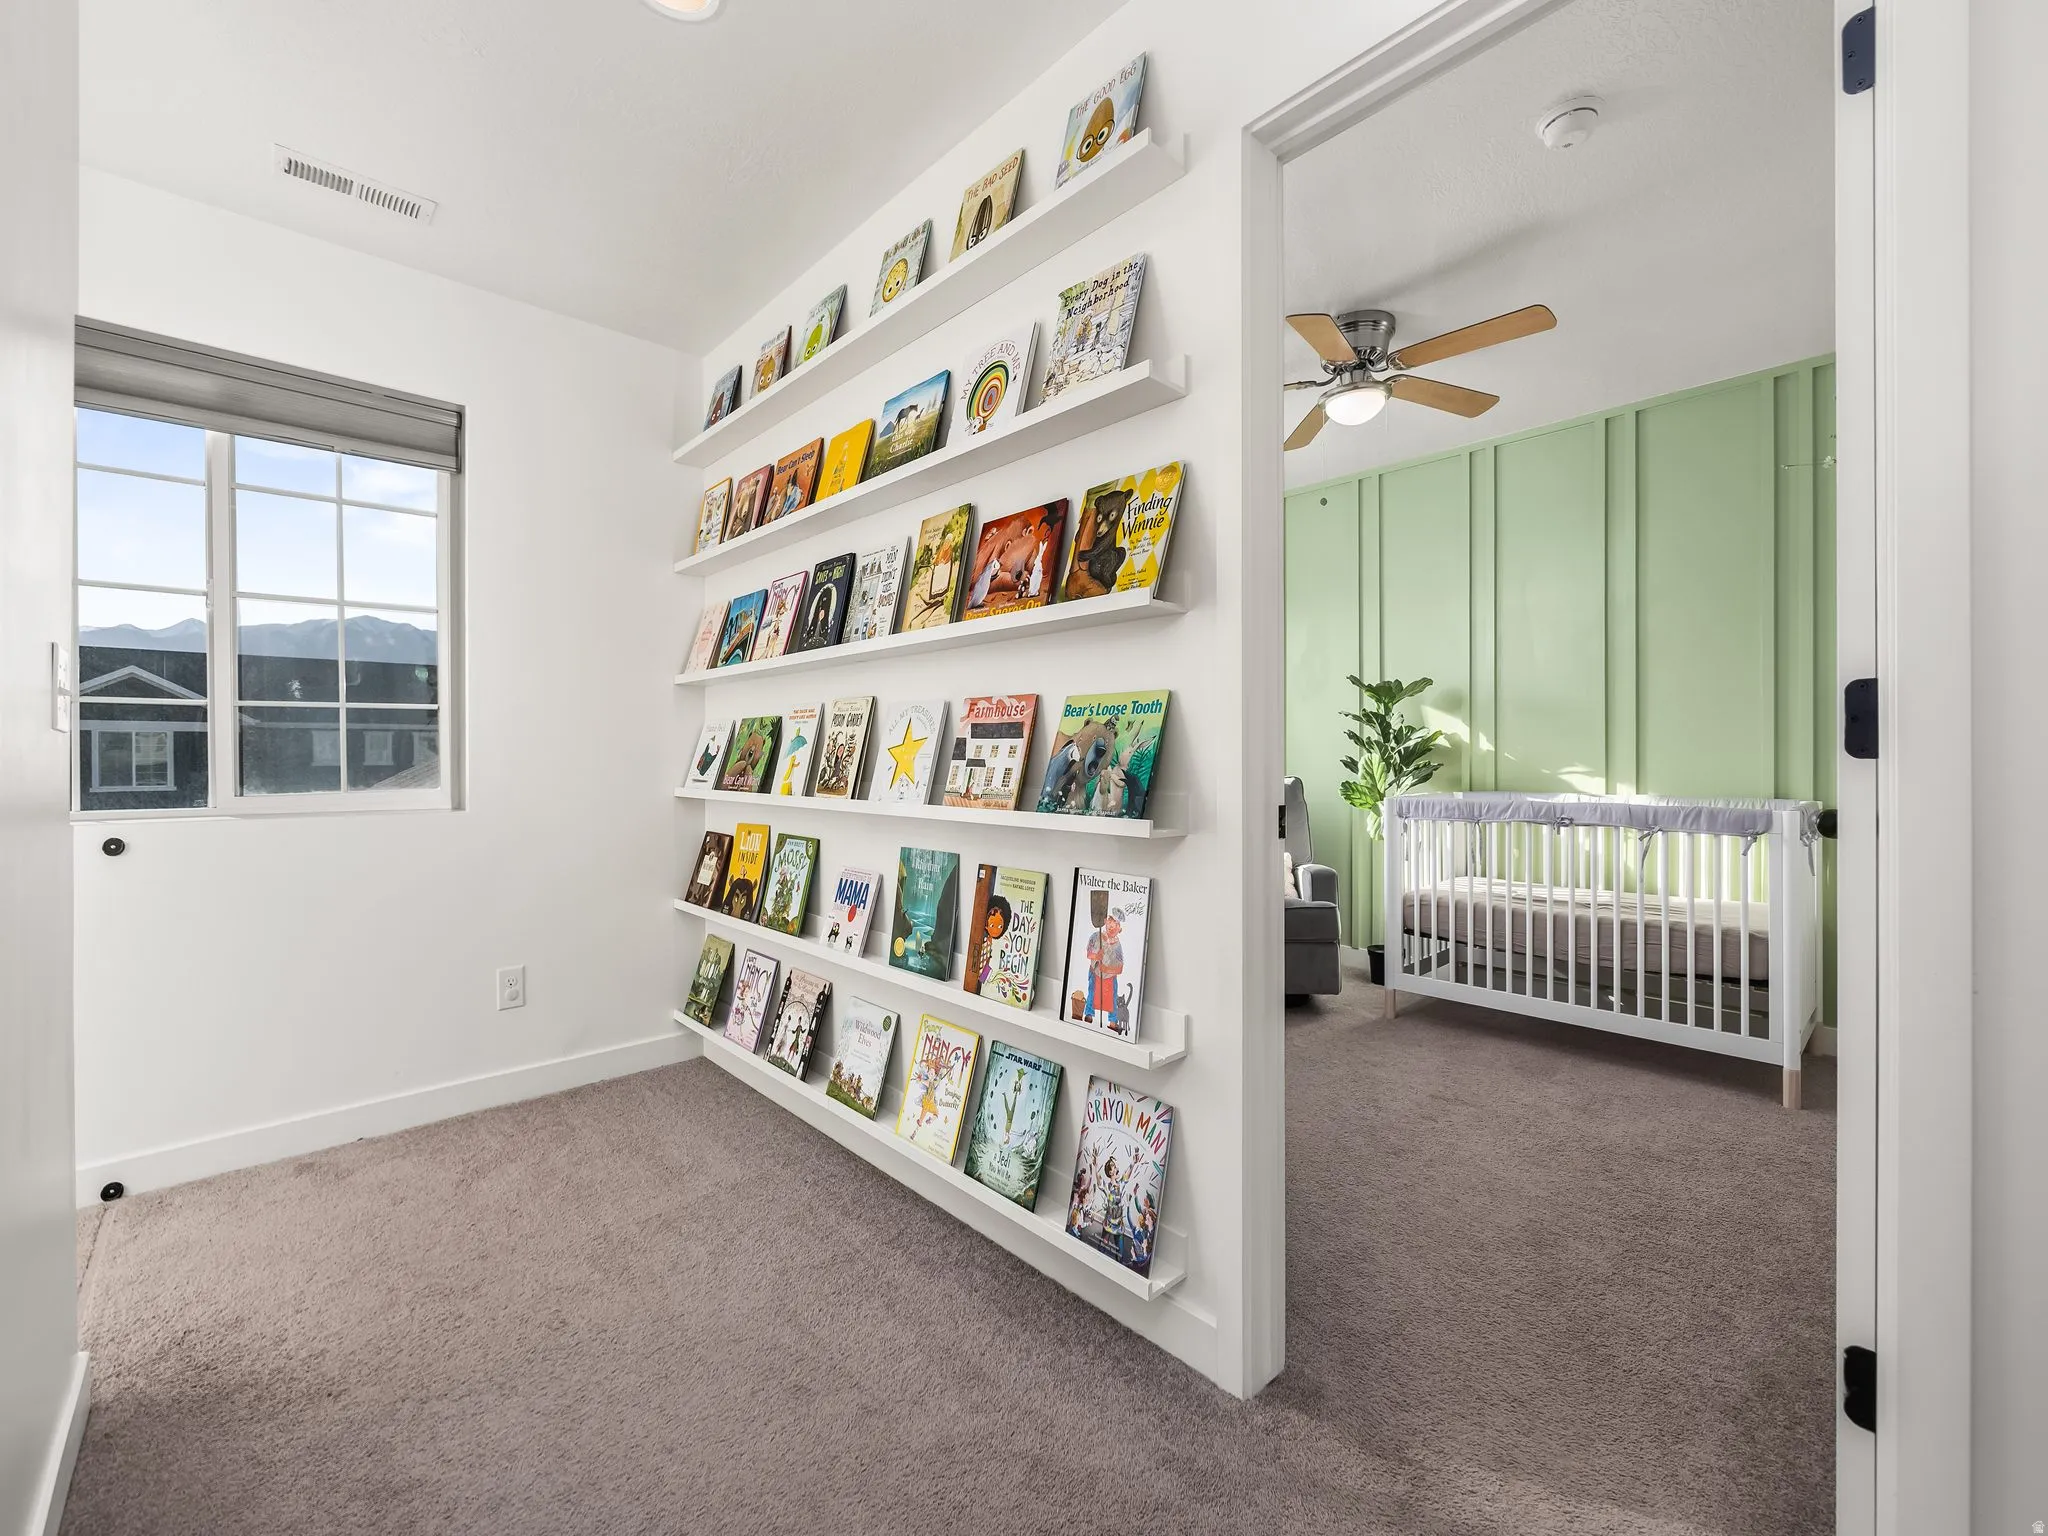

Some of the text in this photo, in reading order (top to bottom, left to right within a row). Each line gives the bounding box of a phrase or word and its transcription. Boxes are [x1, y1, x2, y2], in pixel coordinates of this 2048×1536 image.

[1076, 62, 1137, 119] THE GOOD EGG
[968, 156, 1018, 202] THE BAD SEED
[1064, 261, 1139, 307] Every Dog in the
[1066, 274, 1131, 320] Neighborhood
[960, 379, 972, 400] MY
[972, 347, 996, 374] TREE
[997, 343, 1016, 356] AND
[1012, 352, 1021, 374] ME
[777, 464, 789, 475] Bear
[801, 450, 815, 463] Sleep
[1127, 493, 1173, 520] Finding
[1122, 514, 1165, 540] Winnie
[911, 705, 936, 734] TREASURES
[967, 700, 1025, 719] Farmhouse
[1063, 699, 1163, 718] Bear's Loose Tooth
[738, 851, 759, 865] INSIDE
[774, 849, 808, 873] MOSSY
[834, 878, 870, 910] MAMA
[1079, 874, 1148, 895] Walter the Baker
[1020, 900, 1035, 915] THE
[1012, 912, 1033, 935] DAY
[1009, 931, 1031, 955] YOU
[999, 949, 1029, 976] BEGIN
[855, 1019, 882, 1040] Wildwood
[857, 1033, 871, 1048] Elves
[921, 1033, 971, 1088] NANCY
[1005, 1053, 1042, 1071] STAR WARS
[1087, 1097, 1134, 1128] CRAYON
[1135, 1111, 1166, 1154] MAN
[997, 1150, 1012, 1168] Jedi
